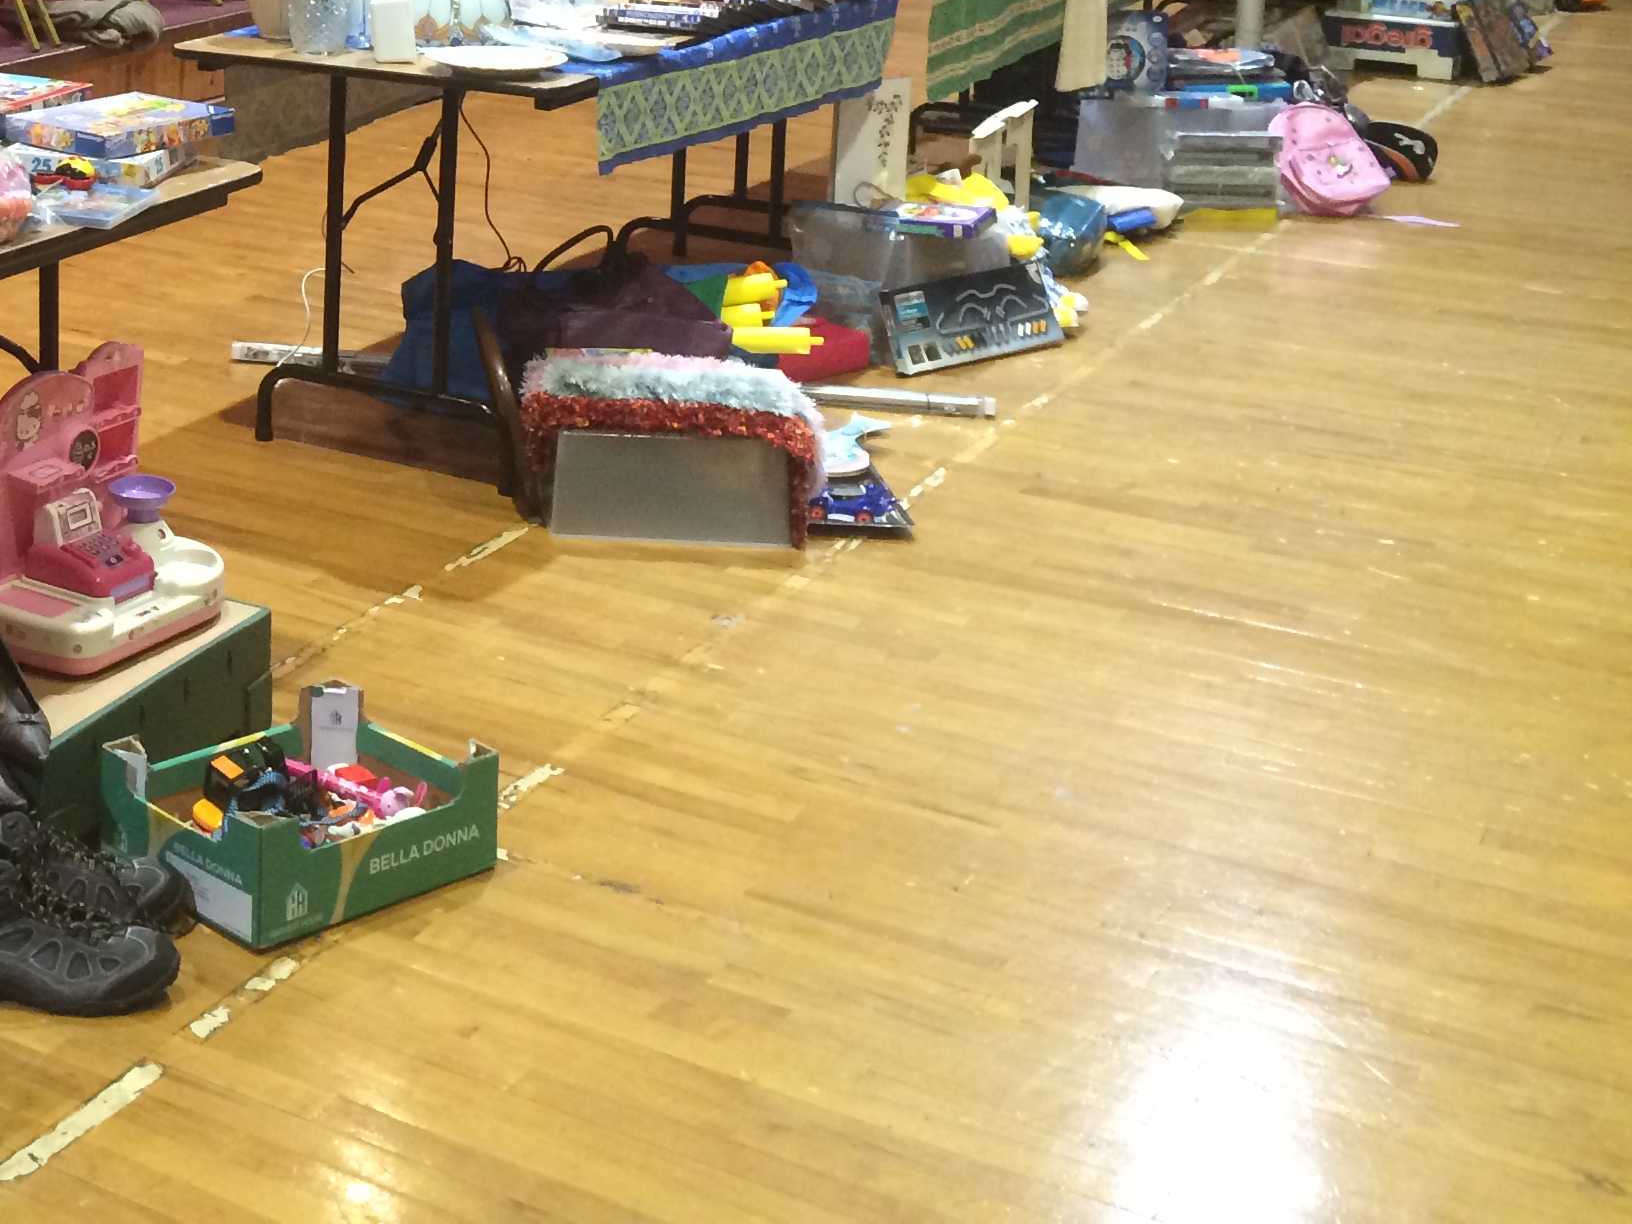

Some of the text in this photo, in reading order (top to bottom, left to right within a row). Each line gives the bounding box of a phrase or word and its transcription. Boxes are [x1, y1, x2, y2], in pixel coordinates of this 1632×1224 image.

[31, 157, 52, 173] 25
[173, 841, 205, 866] BELLA
[204, 856, 243, 886] DONNA
[369, 824, 480, 875] BELLA DONNA
